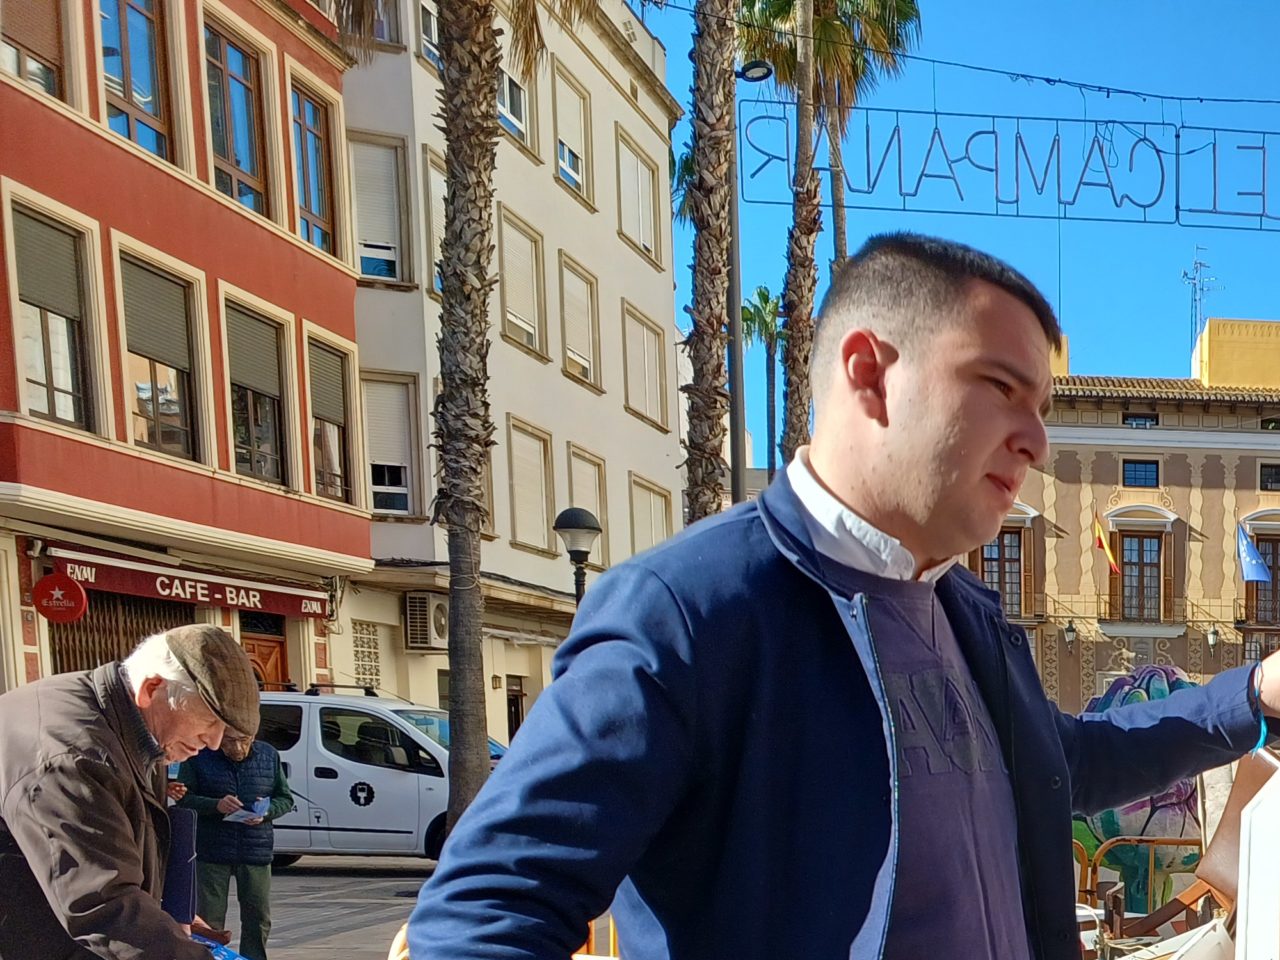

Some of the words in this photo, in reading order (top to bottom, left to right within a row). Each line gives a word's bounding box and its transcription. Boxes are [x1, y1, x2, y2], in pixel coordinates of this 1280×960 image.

[42, 598, 75, 607] Estrella
[156, 576, 210, 602] CAFE
[225, 586, 262, 609] BAR
